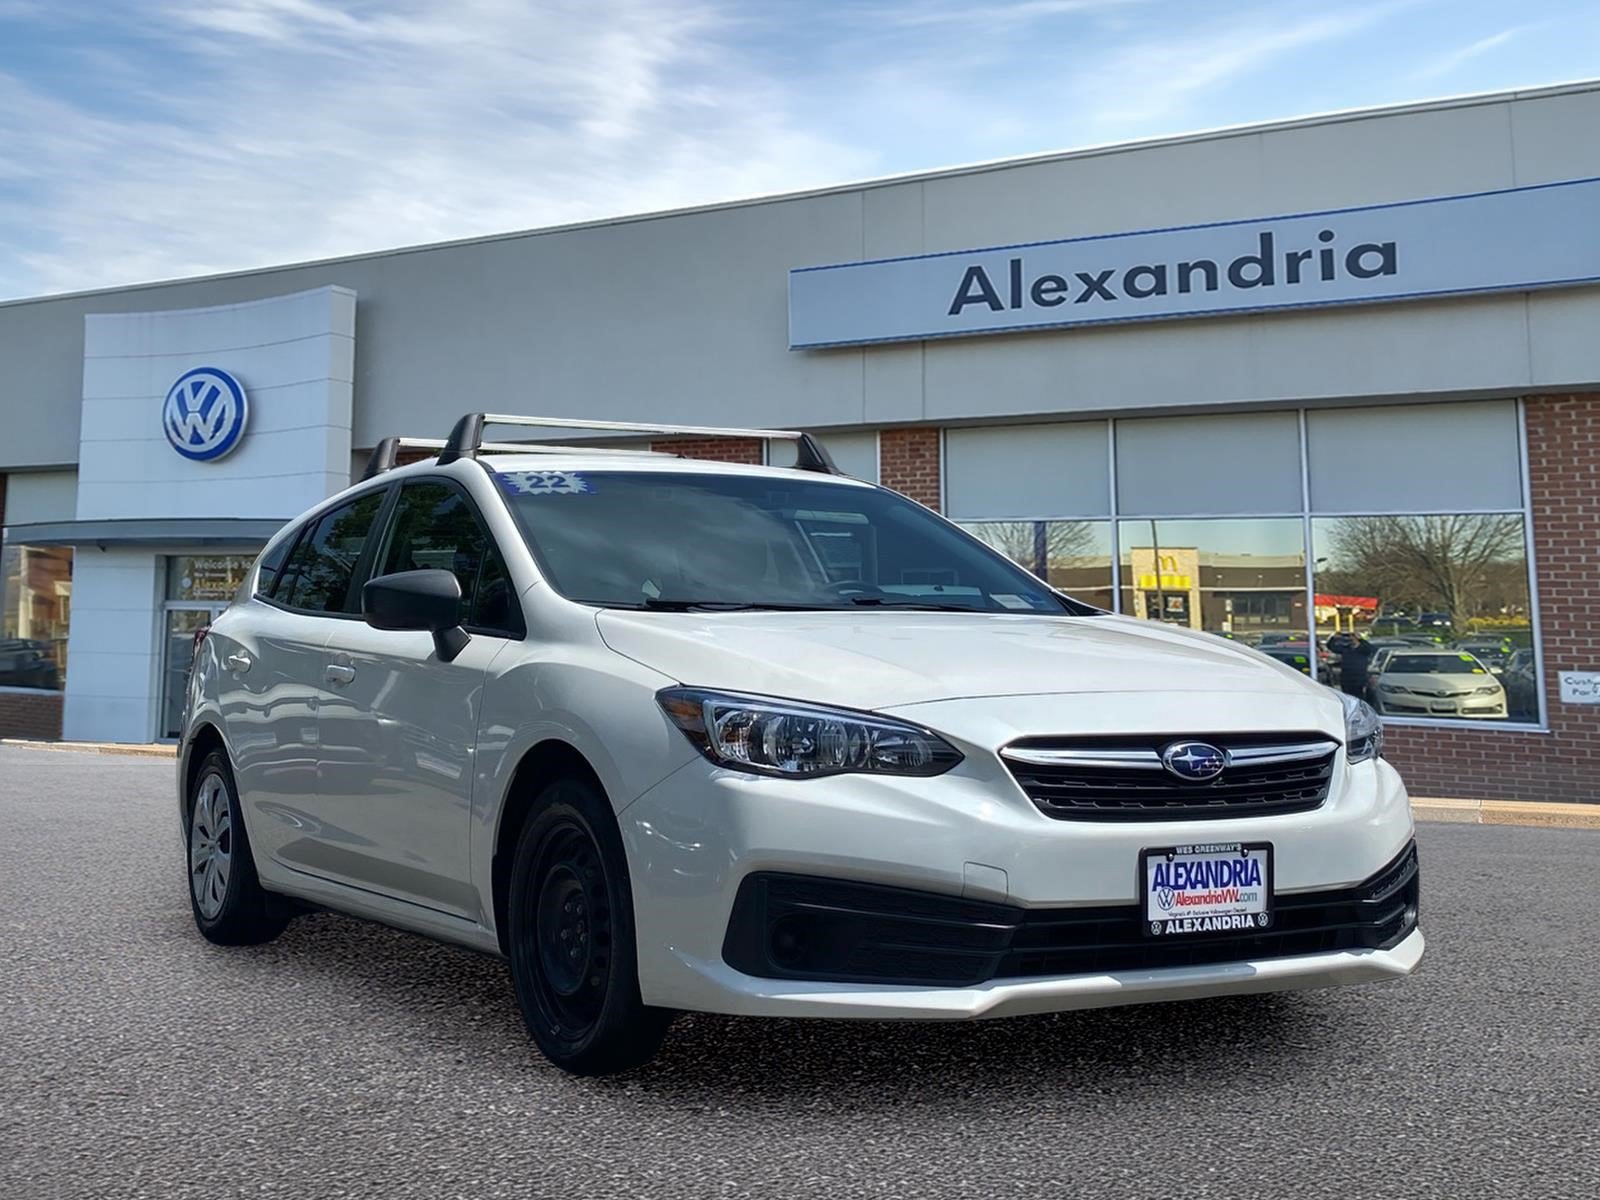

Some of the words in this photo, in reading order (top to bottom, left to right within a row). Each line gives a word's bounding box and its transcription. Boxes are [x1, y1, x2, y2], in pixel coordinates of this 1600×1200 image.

[948, 229, 1398, 316] Alexandria
[525, 475, 570, 489] 22
[194, 558, 238, 569] Welcome
[193, 577, 241, 589] Alexand
[1176, 846, 1193, 855] WES
[1152, 858, 1262, 892] ALEXANDRIA
[1175, 889, 1258, 907] AlexandriaVW.com
[1165, 915, 1255, 934] ALEXANDRIA
